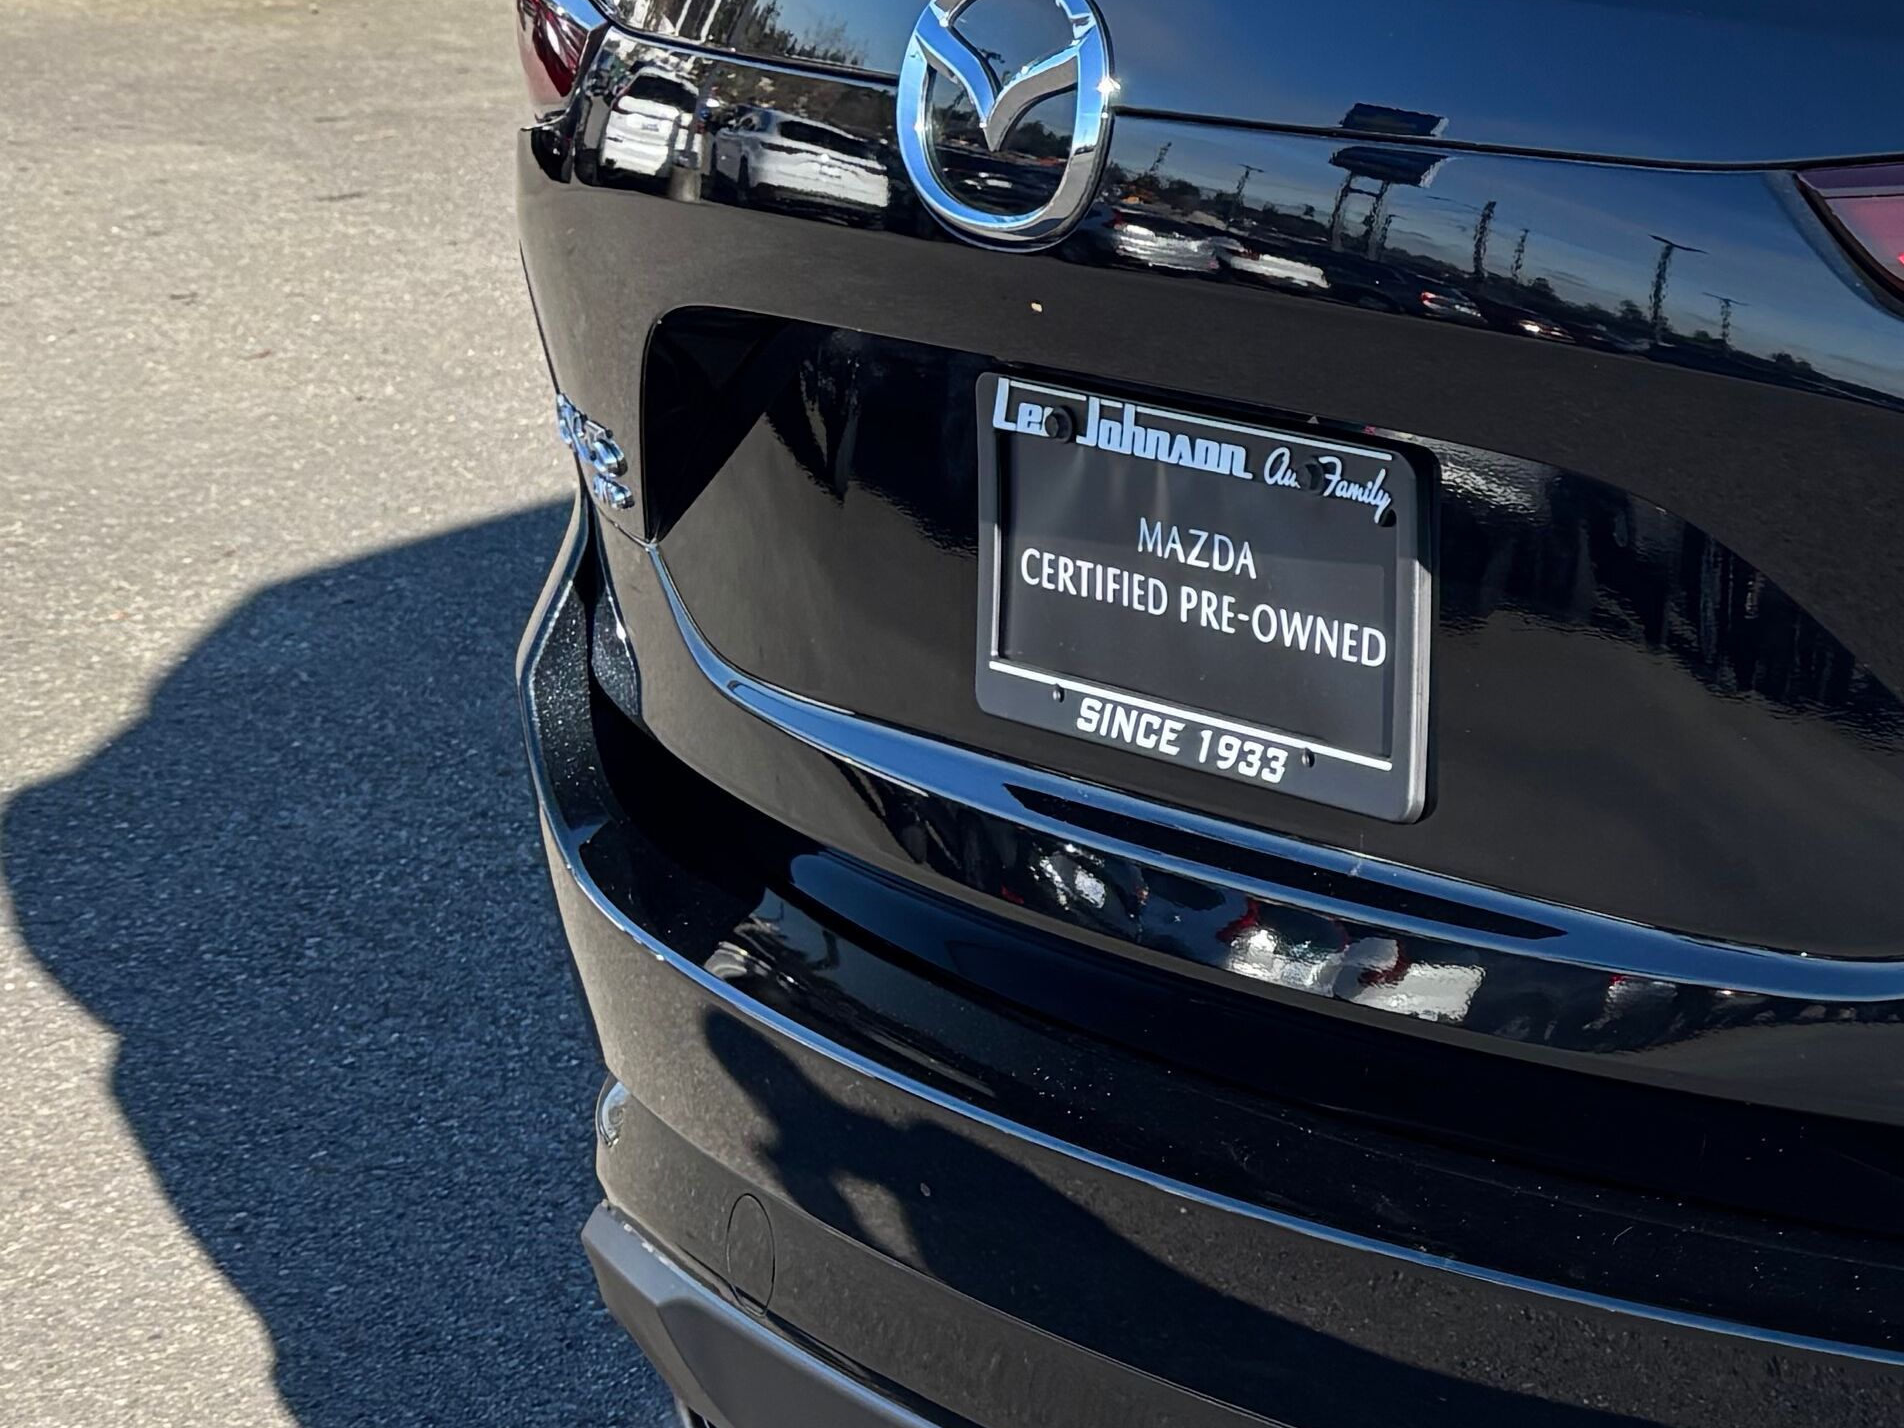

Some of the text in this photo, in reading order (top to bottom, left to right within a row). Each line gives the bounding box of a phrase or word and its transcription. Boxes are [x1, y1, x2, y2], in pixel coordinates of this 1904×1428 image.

[992, 377, 1071, 444] Le
[1075, 396, 1253, 479] Johnson
[1315, 455, 1392, 524] Family
[1136, 516, 1257, 580] MAZDA
[1020, 547, 1387, 668] CERTIFIED PRE-OWNED
[1075, 697, 1289, 784] SINCE 1933
